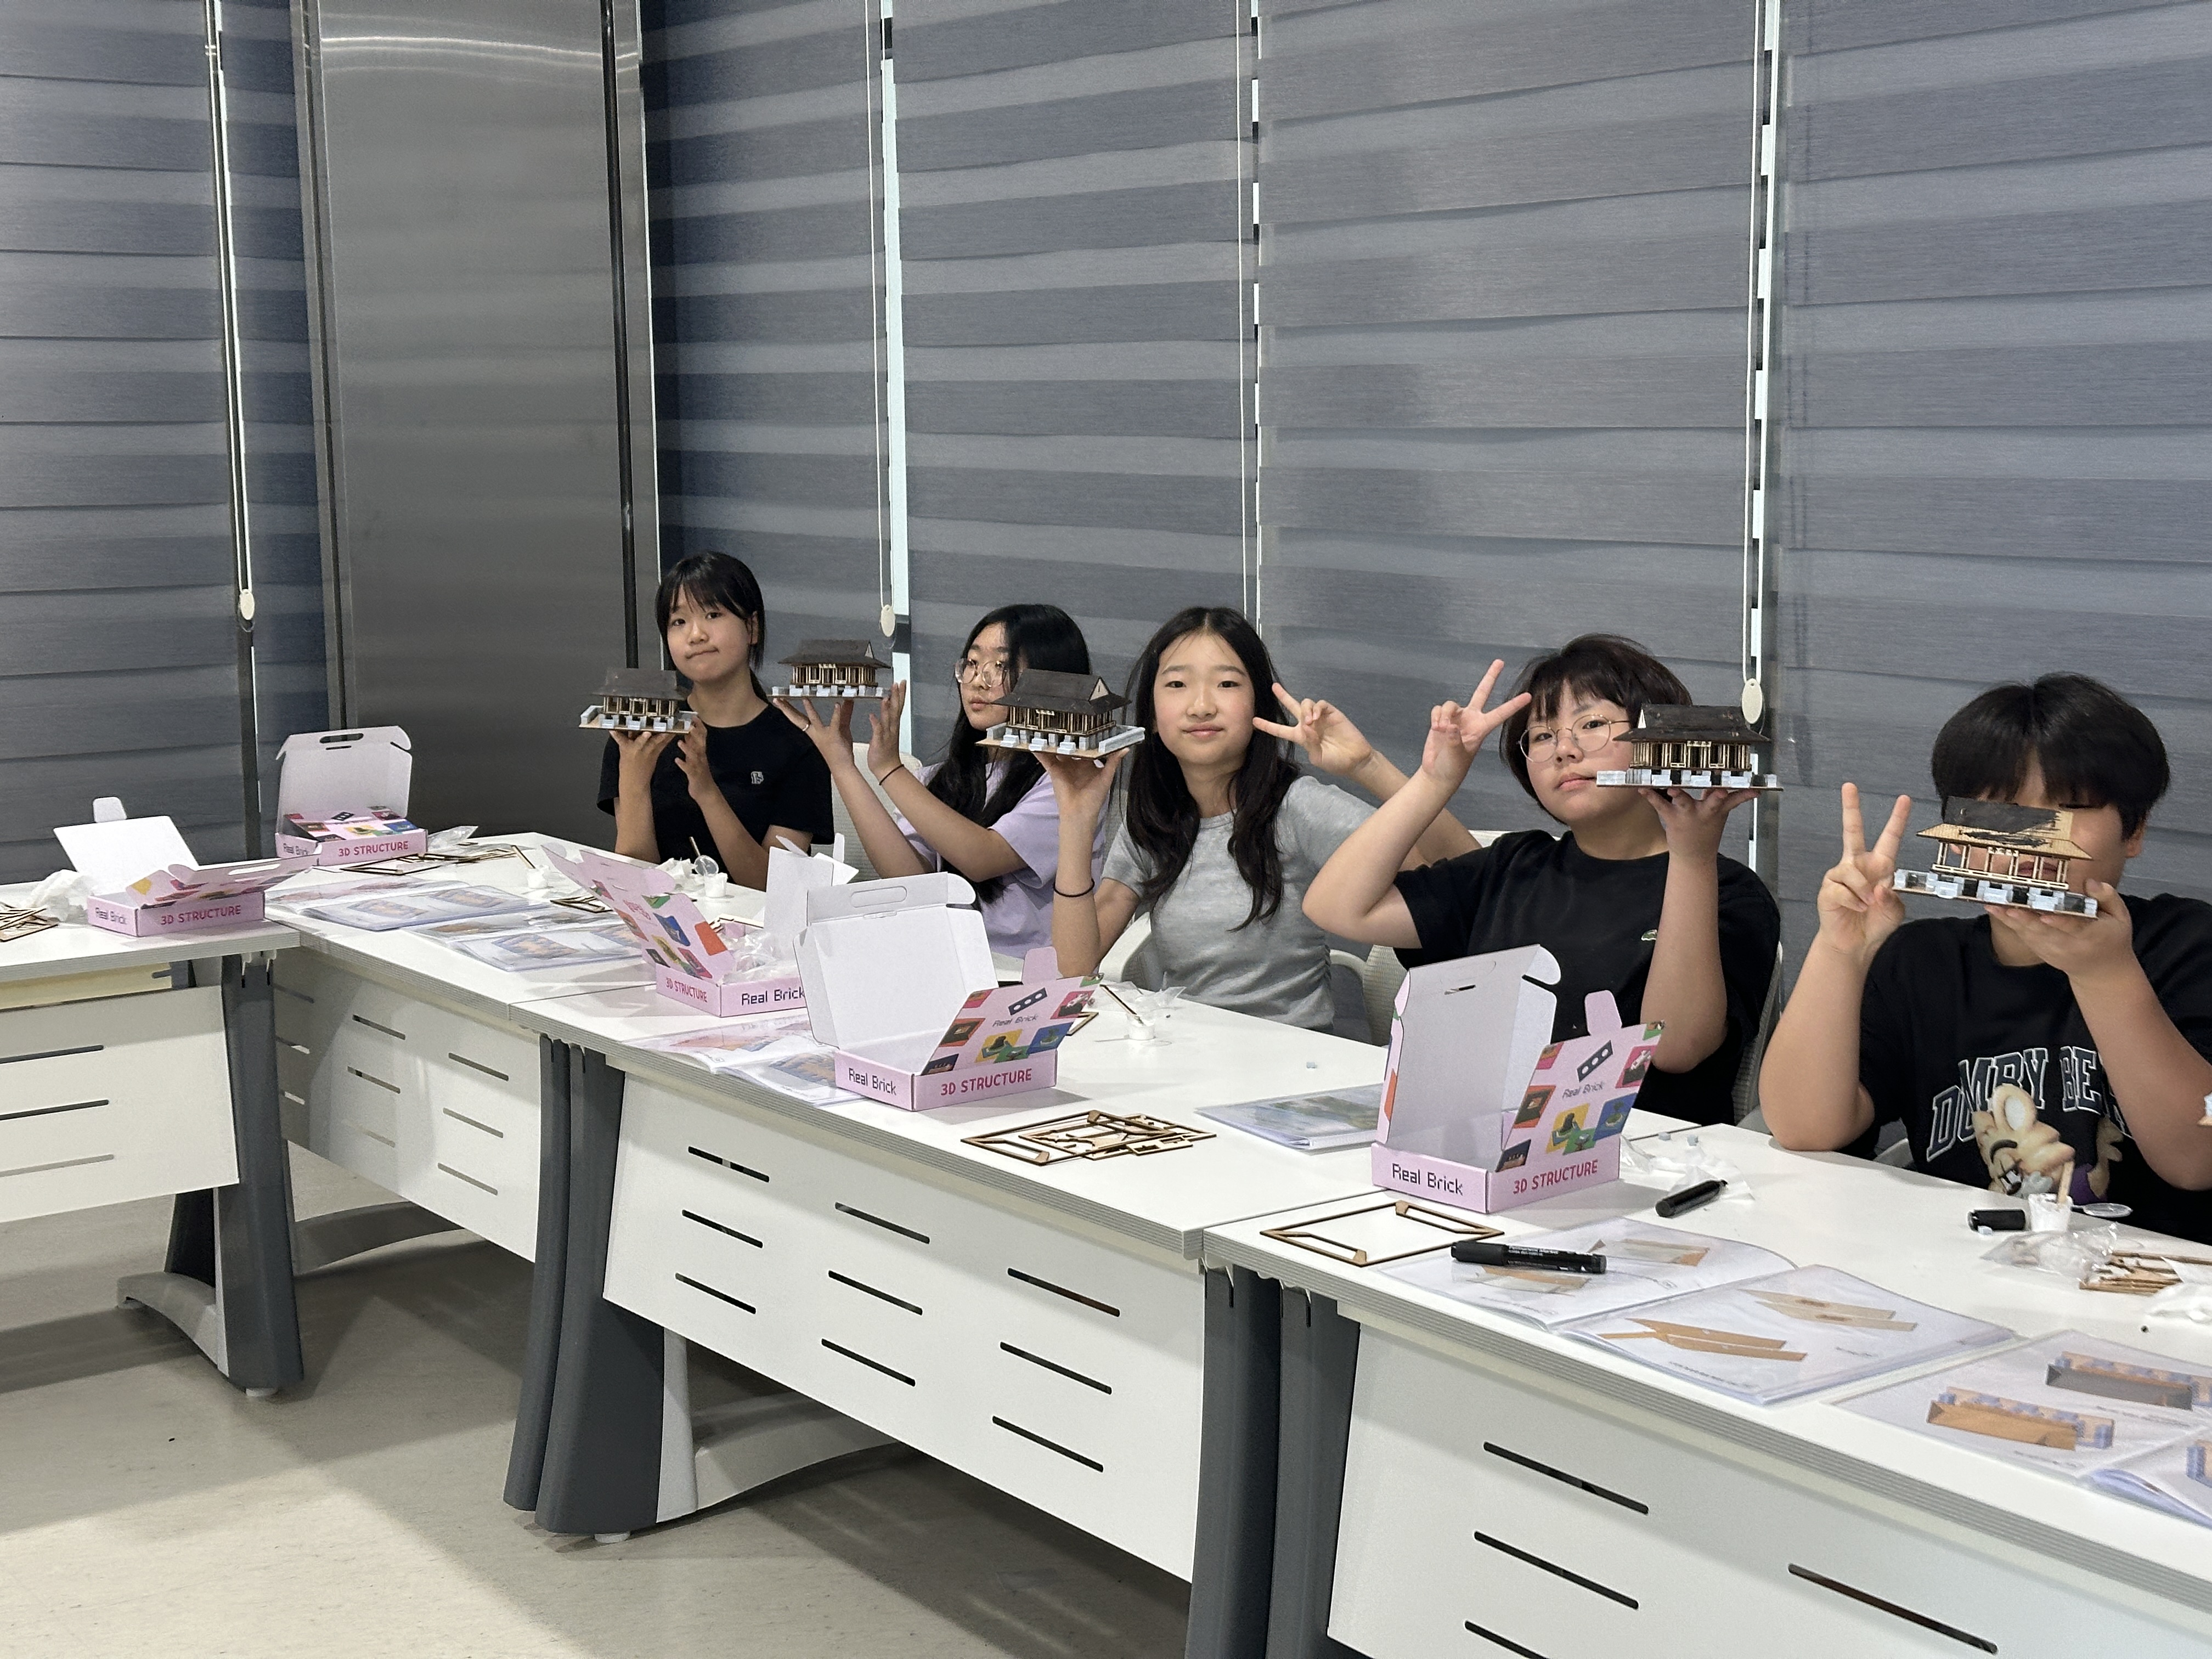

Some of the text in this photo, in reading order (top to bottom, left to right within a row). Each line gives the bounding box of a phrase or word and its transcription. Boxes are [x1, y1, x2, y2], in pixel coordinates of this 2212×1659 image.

[338, 841, 409, 856] 3D STRUCTURE
[161, 905, 241, 925] 3D STRUCTURE
[665, 977, 708, 1003] 3D STRUCTURE
[742, 986, 805, 1006] Real Brick
[992, 1014, 1039, 1027] Real Brick
[848, 1067, 896, 1096] Real Brick
[940, 1068, 1032, 1096] 3D STRUCTURE
[1392, 1163, 1463, 1196] Real Brick
[1513, 1159, 1599, 1195] 3D STRUCTURE
